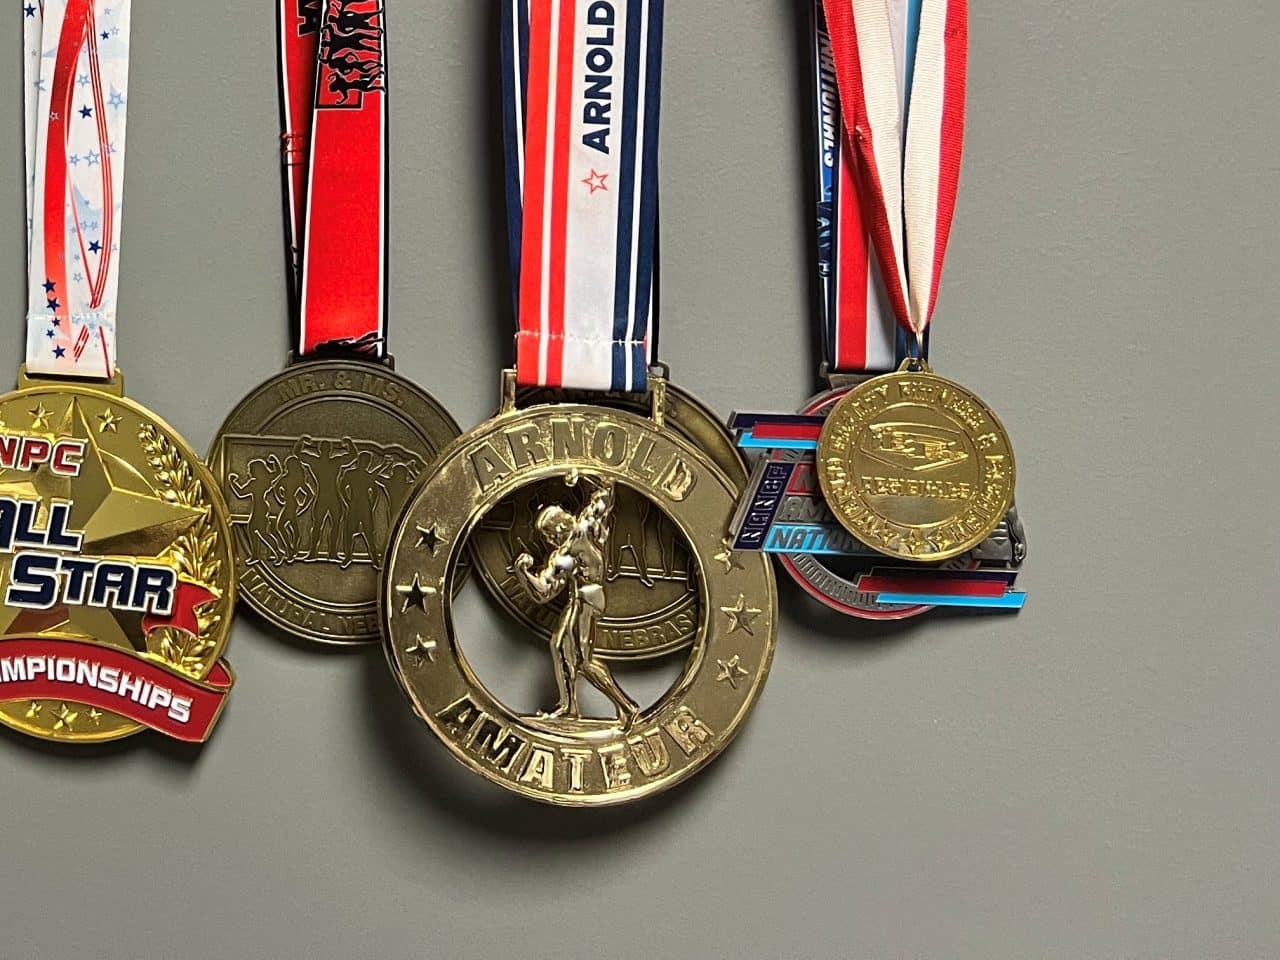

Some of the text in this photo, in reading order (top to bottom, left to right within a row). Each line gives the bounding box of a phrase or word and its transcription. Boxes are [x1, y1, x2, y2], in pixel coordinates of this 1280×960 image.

[581, 0, 616, 155] ARNOLD
[466, 418, 698, 503] ARNOLD
[4, 551, 178, 615] STAR
[602, 608, 696, 649] NEBRAS
[435, 692, 714, 793] AMATEUR
